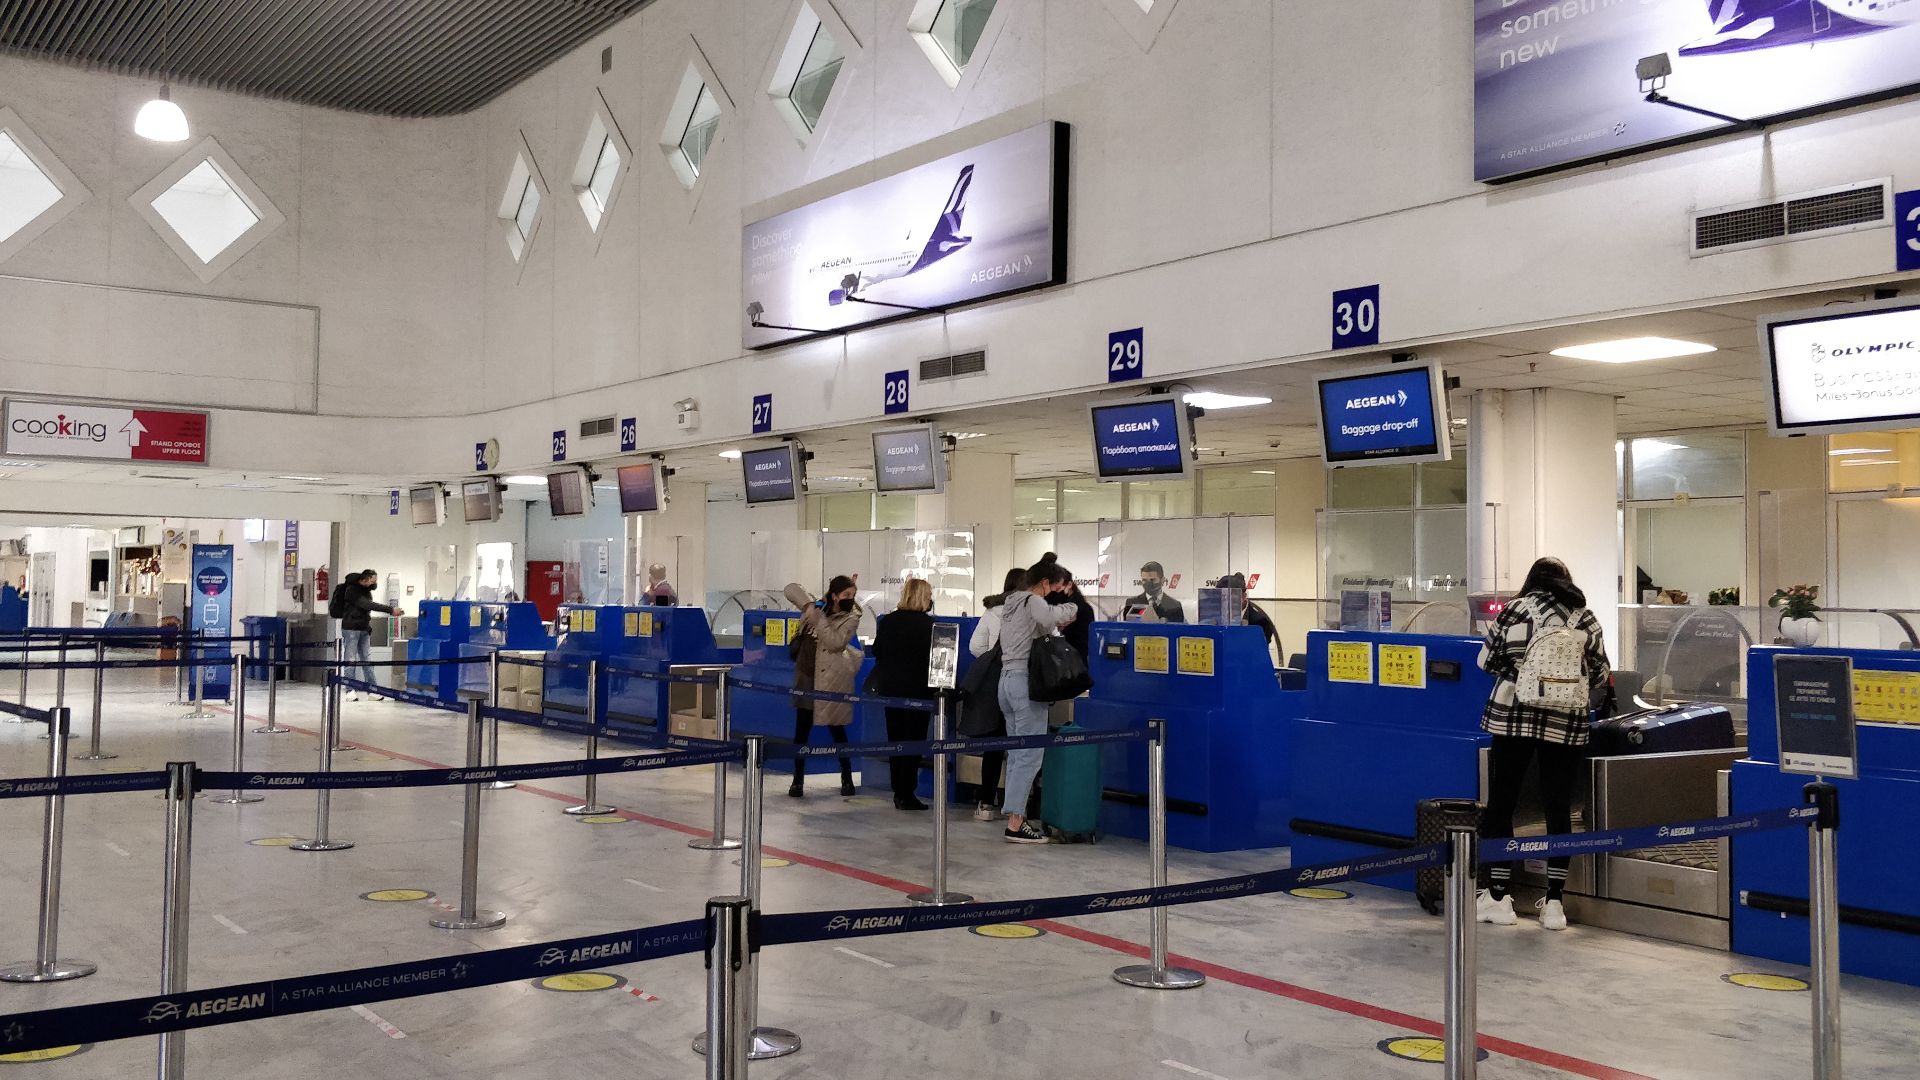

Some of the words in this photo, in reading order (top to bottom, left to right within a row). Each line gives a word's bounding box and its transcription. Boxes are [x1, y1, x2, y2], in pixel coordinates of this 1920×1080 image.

[1500, 0, 1628, 38] somet
[1500, 36, 1558, 69] new
[1508, 148, 1527, 159] STAR
[1529, 139, 1569, 153] ALLIANCE
[1570, 128, 1610, 144] MEMBER
[752, 228, 792, 250] Discover
[1906, 206, 1920, 252] 3
[750, 243, 801, 268] something
[970, 262, 1021, 284] AEGEAN
[1336, 298, 1376, 336] 30
[1110, 339, 1141, 372] 29
[1832, 340, 1915, 357] OLYMPIC
[886, 379, 907, 406] 28
[1346, 394, 1396, 410] AEGEAN
[754, 402, 771, 426] 27
[12, 416, 106, 442] cooking
[622, 424, 634, 444] 26
[1112, 422, 1150, 433] AEGEAN
[1342, 423, 1381, 437] Baggage
[1382, 417, 1418, 432] drop-off
[553, 436, 565, 456] 25
[887, 446, 914, 455] AEGEAN
[1102, 444, 1138, 455] Παράδοση
[1138, 442, 1177, 453] αποσκευών
[476, 449, 486, 465] 2
[754, 462, 777, 471] AEGEAN
[1073, 576, 1100, 588] issport
[1342, 577, 1366, 586] Goldair
[1366, 577, 1394, 588] Handling
[637, 757, 666, 766] AEGEAN
[464, 770, 498, 780] AEGEAN
[16, 782, 58, 792] AEGEAN
[1670, 826, 1696, 836] AEGEAN
[1520, 842, 1548, 852] AEGEAN
[1314, 865, 1350, 880] AEGEAN
[1360, 862, 1374, 872] STAR
[1375, 858, 1402, 868] ALLIANCE
[1404, 853, 1428, 863] MEMBER
[1108, 894, 1152, 907] AEGEAN
[1182, 887, 1214, 896] ALLIANCE
[852, 914, 904, 930] AEGEAN
[920, 914, 942, 922] STAR
[944, 911, 984, 920] ALLIANCE
[985, 907, 1021, 918] MEMBER
[569, 940, 633, 963] AEGEAN
[643, 940, 650, 948] A
[653, 934, 680, 948] STAR
[682, 930, 708, 940] ALLI
[186, 992, 266, 1018] AEGEAN
[292, 986, 324, 1000] STAR
[328, 976, 390, 994] ALLIANCE
[393, 968, 446, 985] MEMBER
